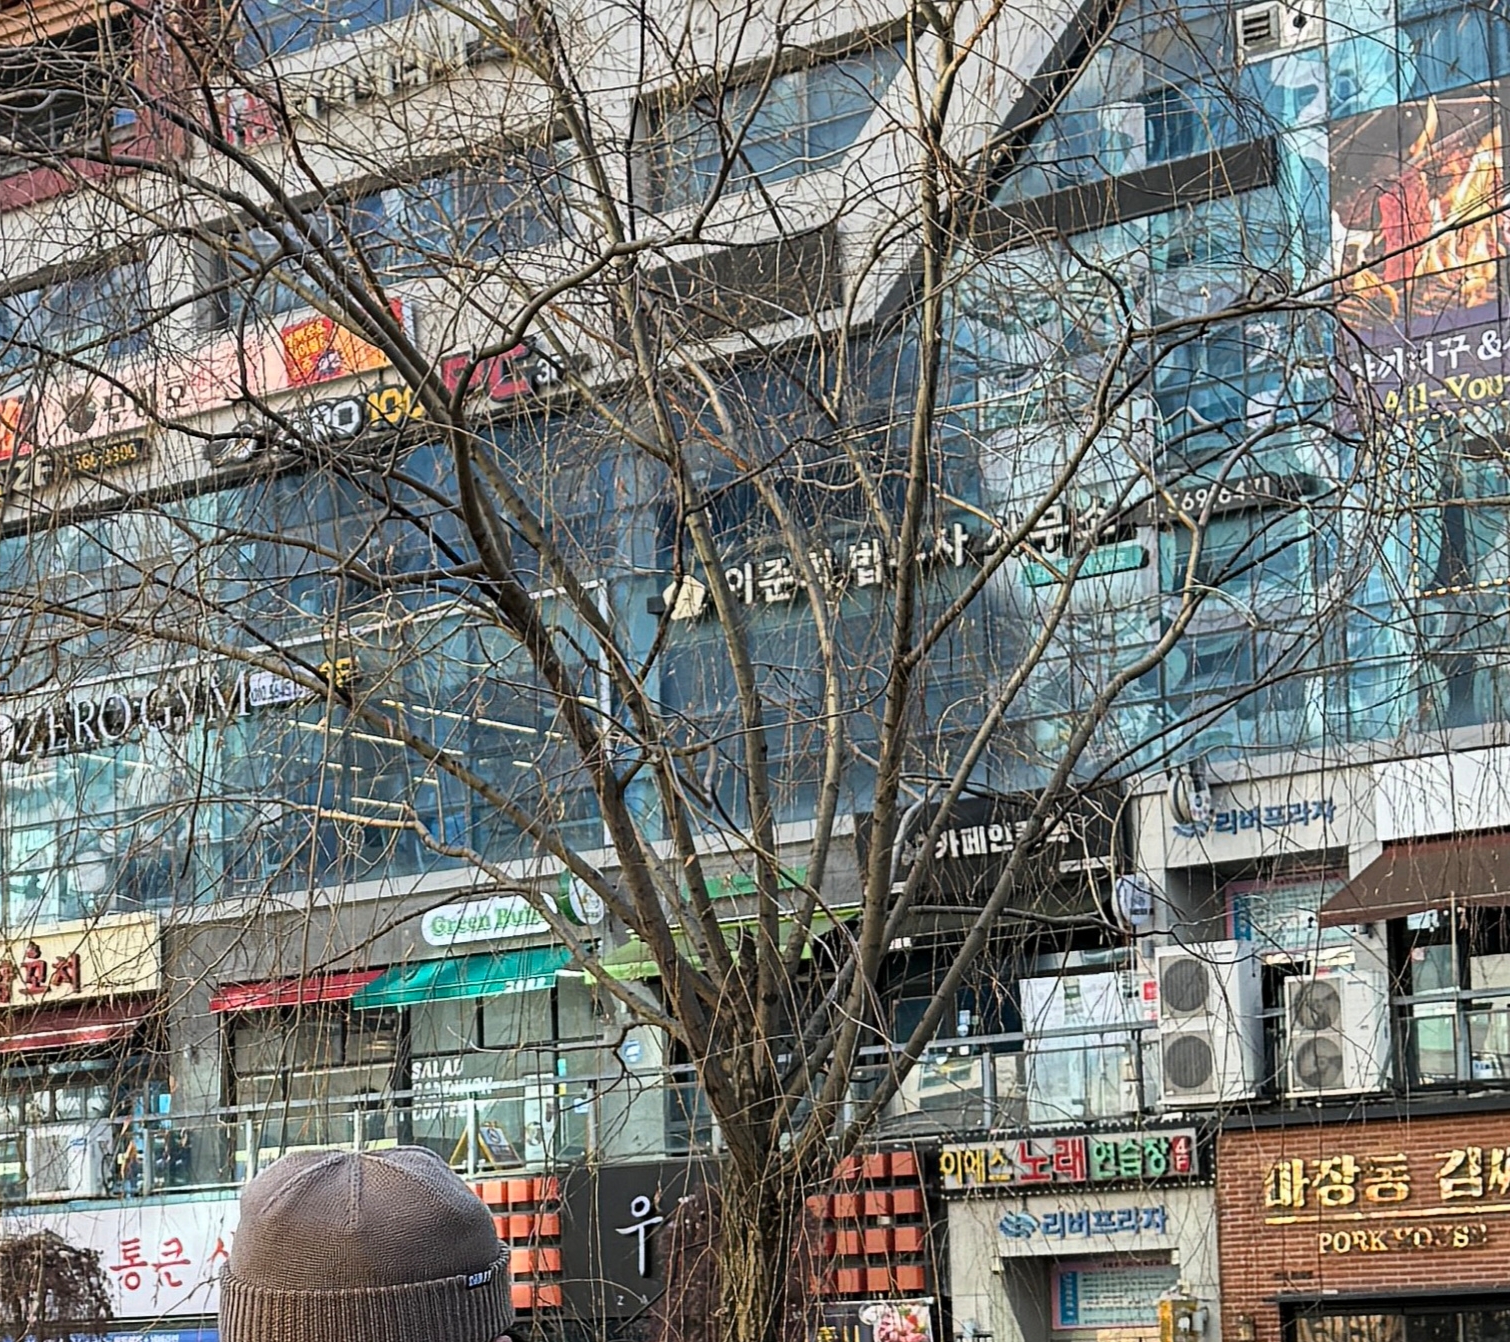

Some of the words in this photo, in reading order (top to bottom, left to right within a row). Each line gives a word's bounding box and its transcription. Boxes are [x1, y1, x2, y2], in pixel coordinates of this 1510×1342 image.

[1214, 799, 1337, 835] 리버프라자
[430, 912, 491, 938] Green
[411, 1057, 464, 1080] SALAD
[1019, 1138, 1086, 1182] 노래
[1092, 1137, 1170, 1179] 연습장
[1264, 1153, 1412, 1207] 마장동
[1041, 1204, 1169, 1239] 리버프라자
[1318, 1230, 1389, 1254] PORK
[109, 1236, 191, 1291] 통큰
